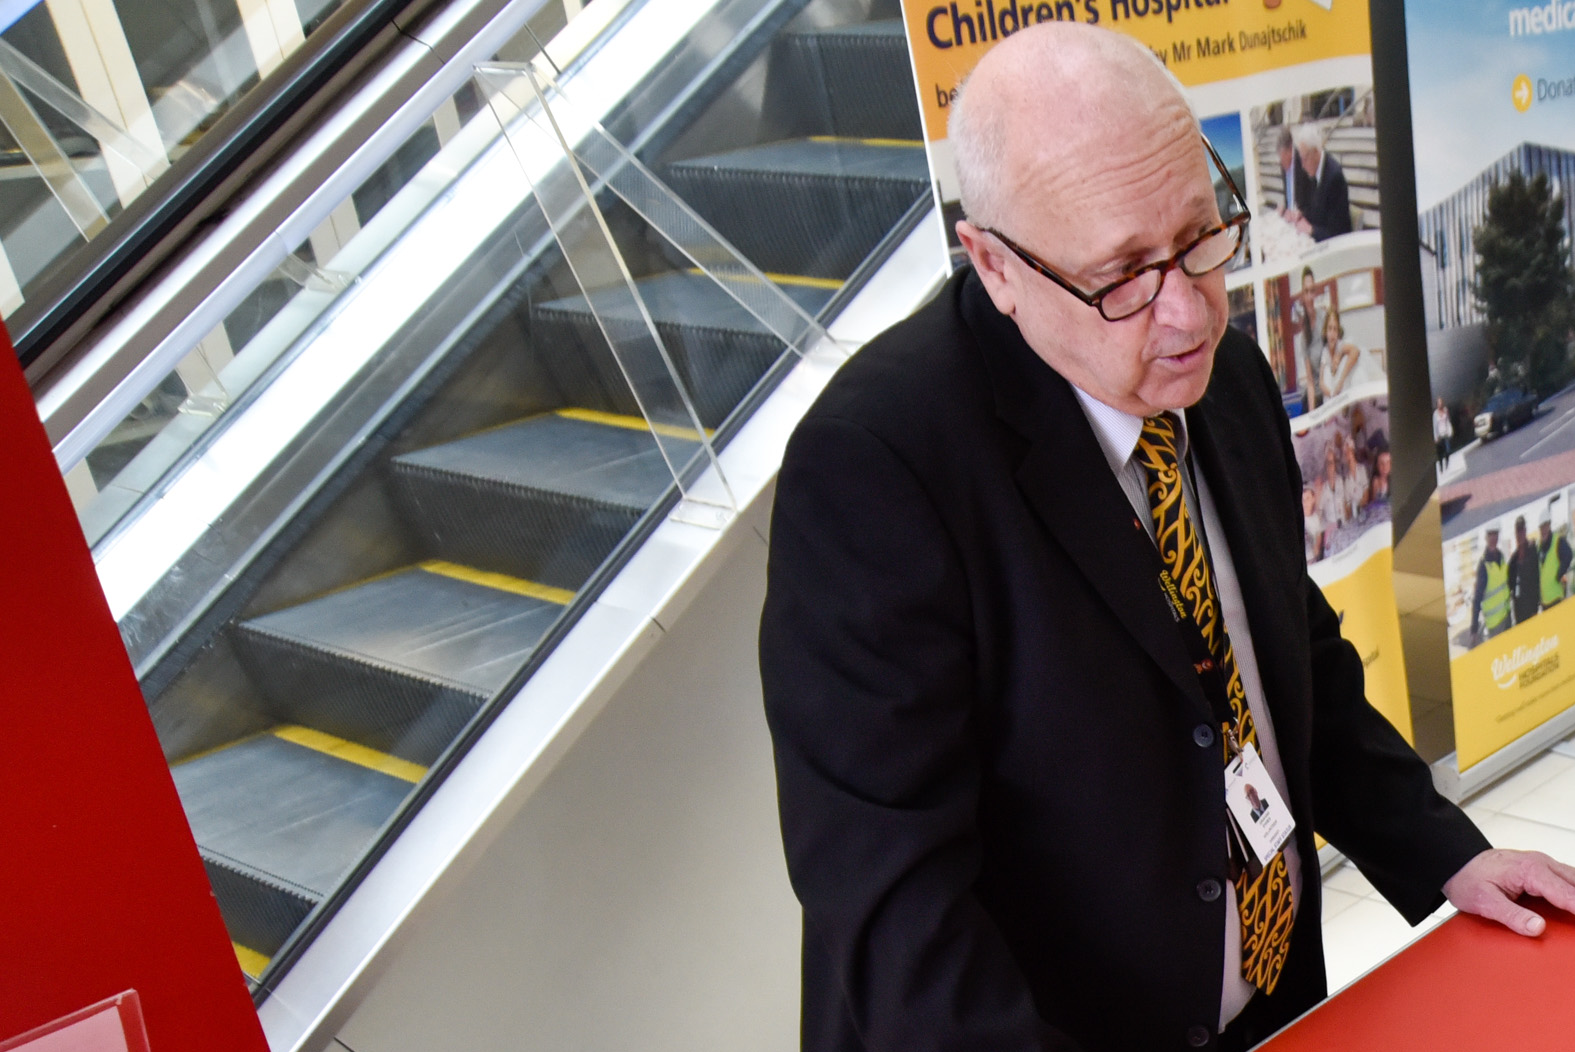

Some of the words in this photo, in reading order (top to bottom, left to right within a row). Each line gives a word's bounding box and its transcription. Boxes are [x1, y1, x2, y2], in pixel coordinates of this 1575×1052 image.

[1172, 41, 1193, 63] Mr
[1197, 33, 1236, 59] Mark
[1239, 18, 1308, 50] Dunajtschik
[1490, 633, 1559, 680] Wellington
